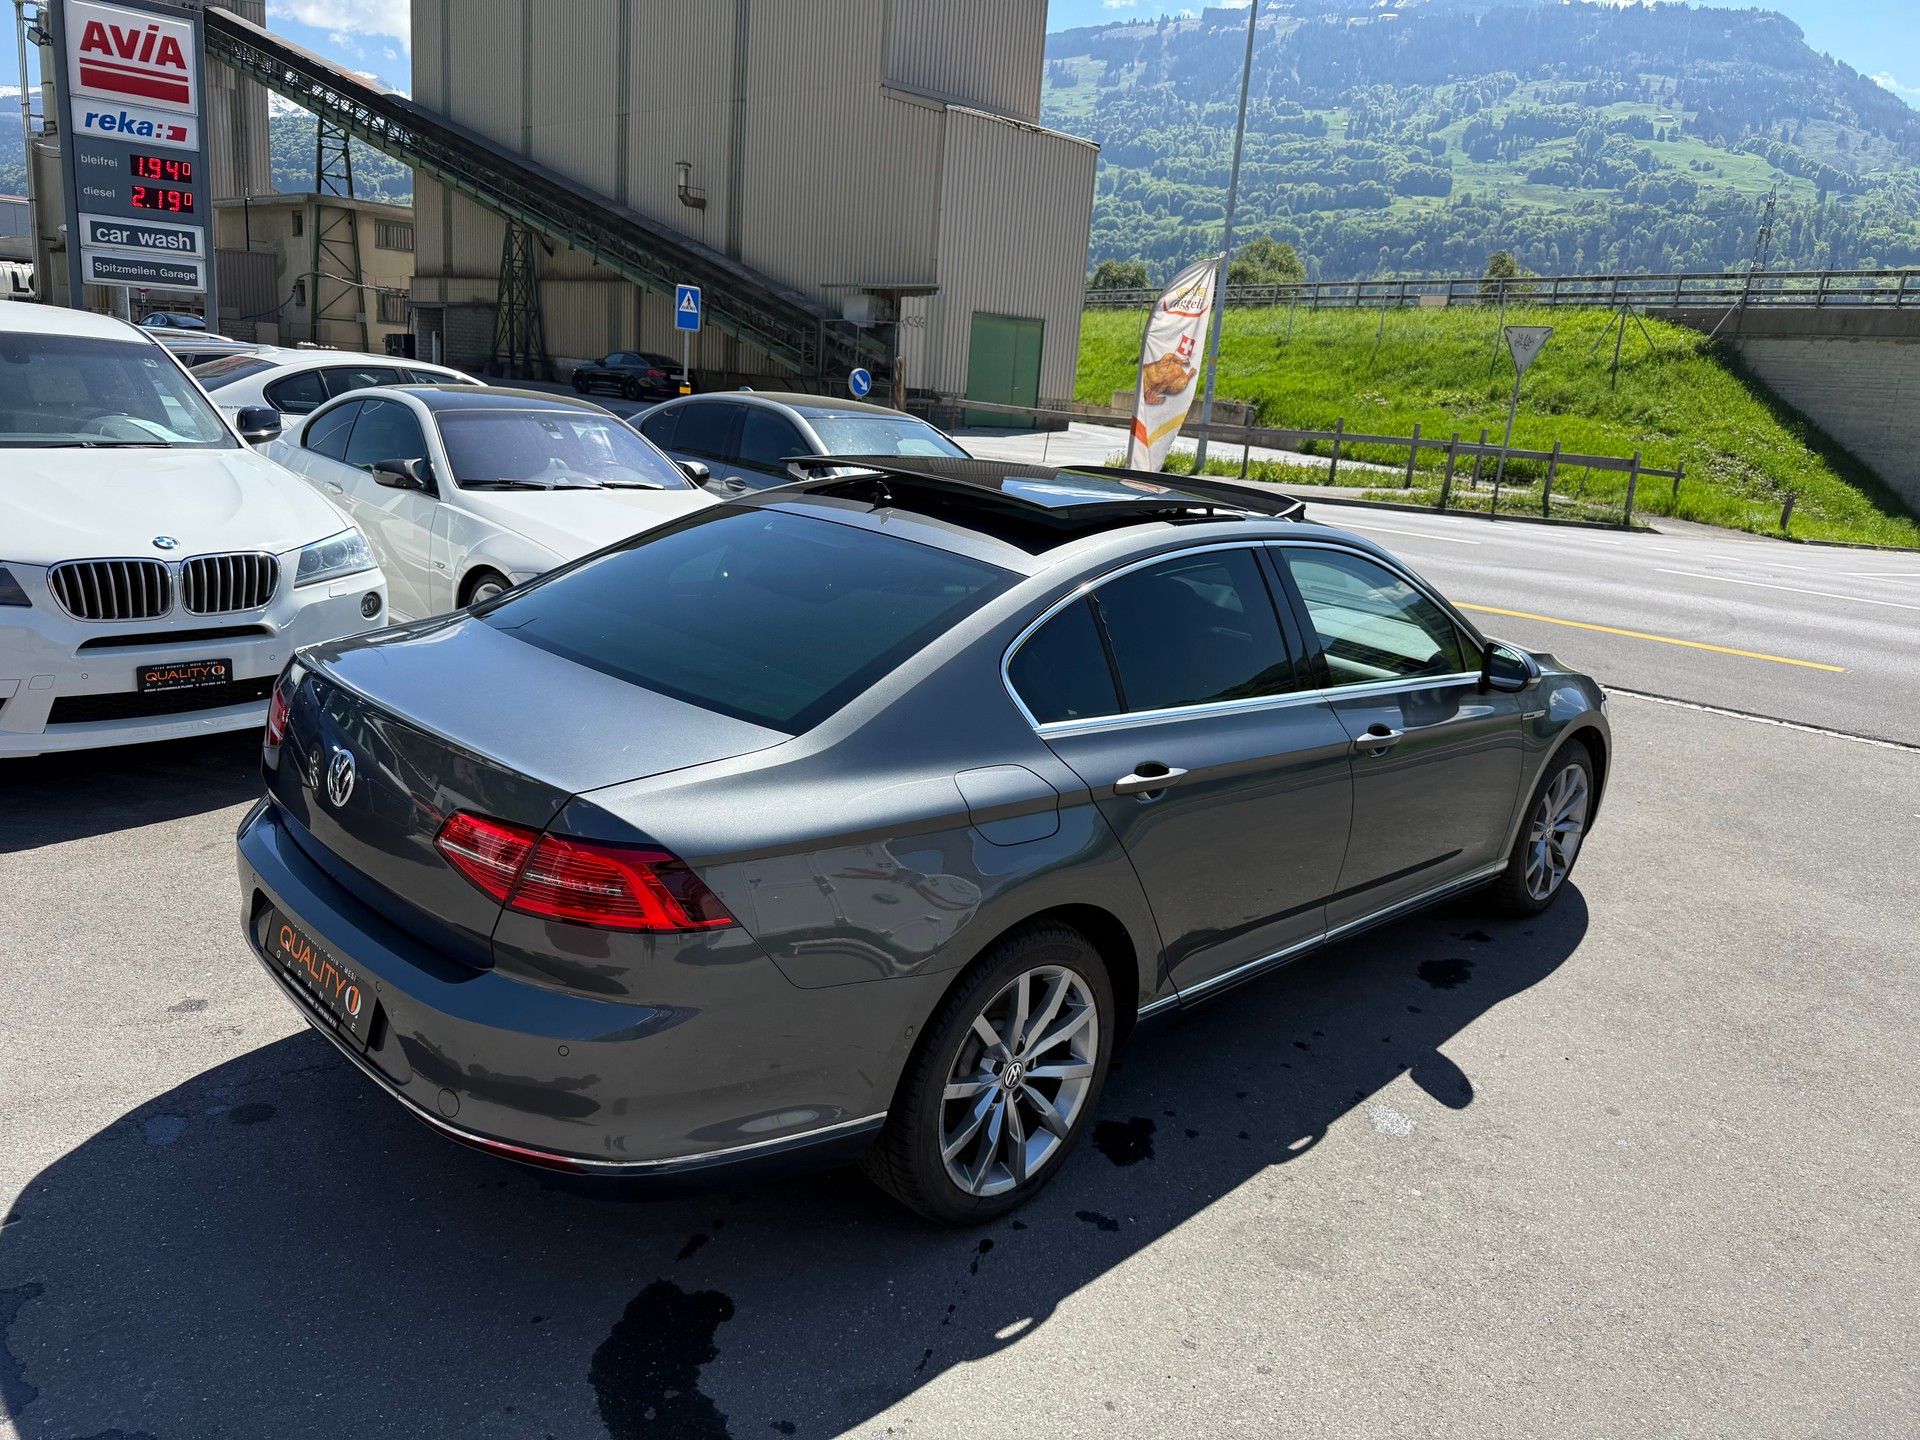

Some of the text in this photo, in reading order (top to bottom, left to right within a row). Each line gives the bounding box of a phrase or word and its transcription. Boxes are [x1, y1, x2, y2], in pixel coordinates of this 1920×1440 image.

[80, 154, 118, 168] bleifrei
[83, 186, 116, 199] diesel
[96, 228, 191, 250] car wash
[94, 262, 196, 281] Spitzmeilen Garage
[276, 950, 356, 1032] GARANTIE
